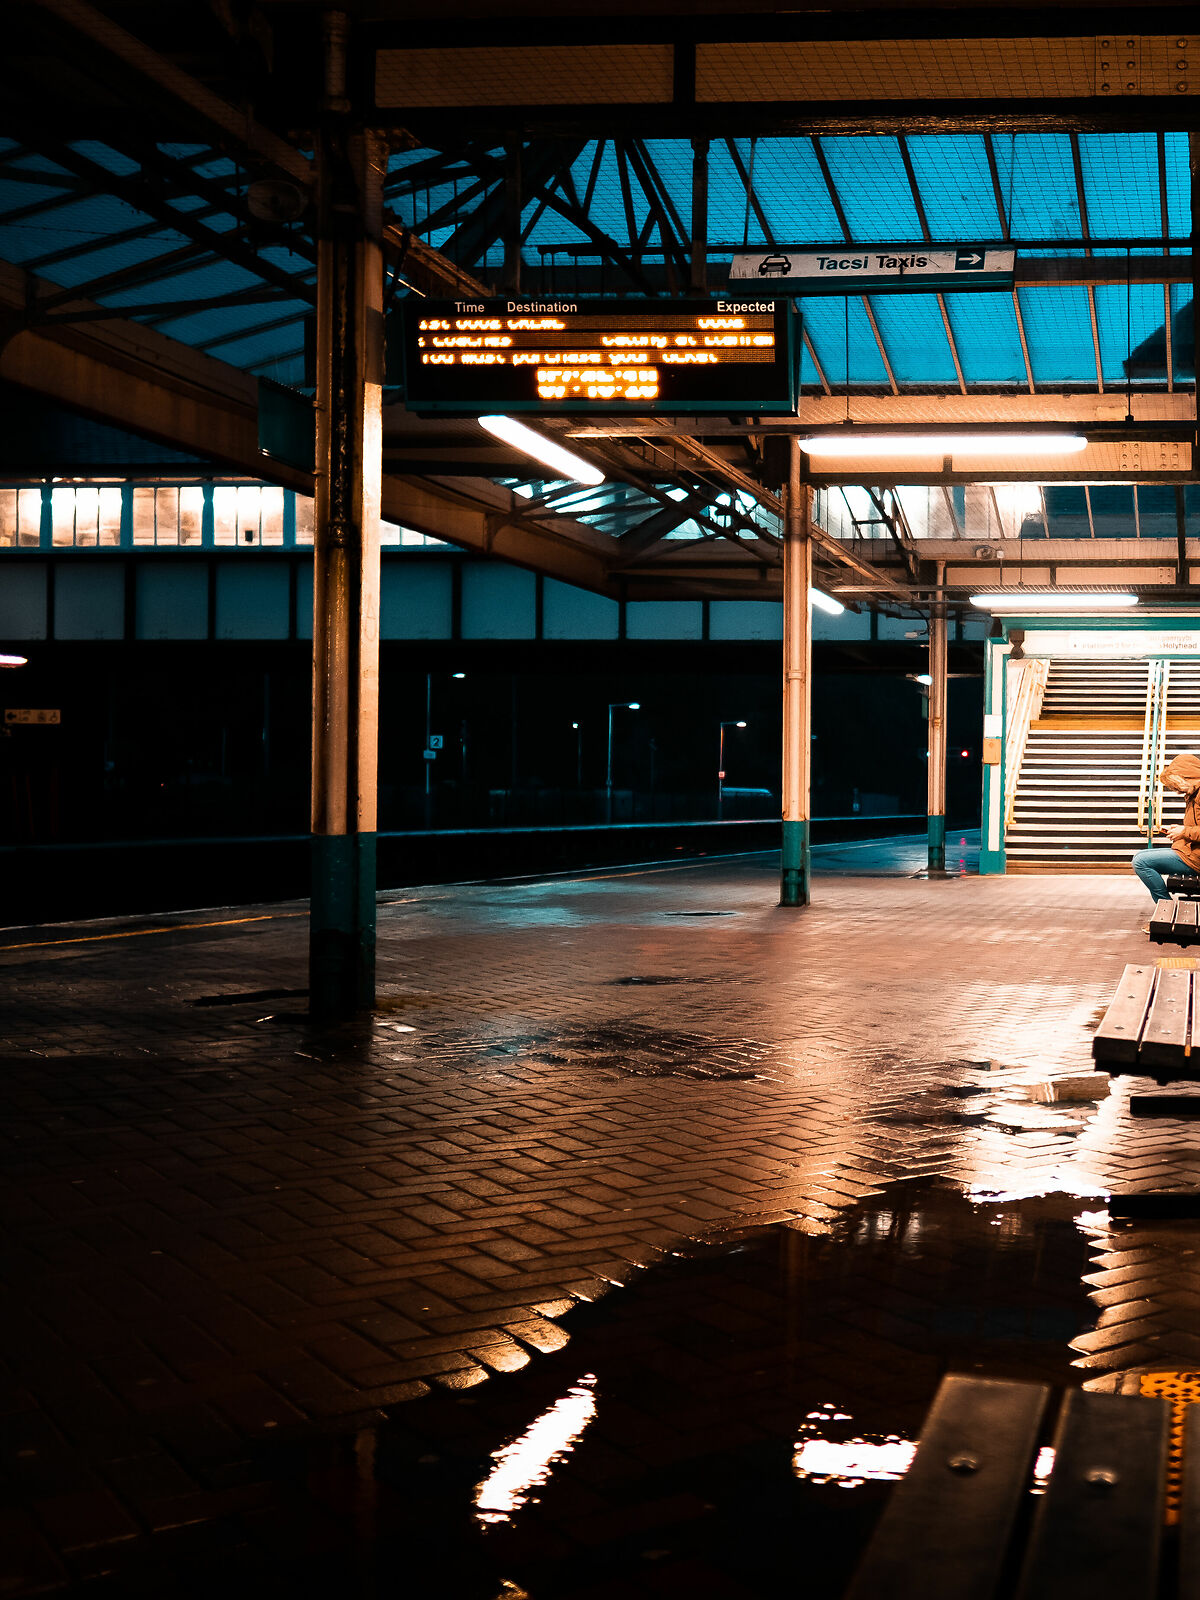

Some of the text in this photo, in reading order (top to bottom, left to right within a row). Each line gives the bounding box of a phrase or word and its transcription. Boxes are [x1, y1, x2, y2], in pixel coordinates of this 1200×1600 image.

[816, 254, 928, 270] Tacsi Taxis
[454, 301, 775, 315] Time Destination Expected
[1163, 642, 1197, 650] Holyhead
[433, 737, 440, 746] 2
